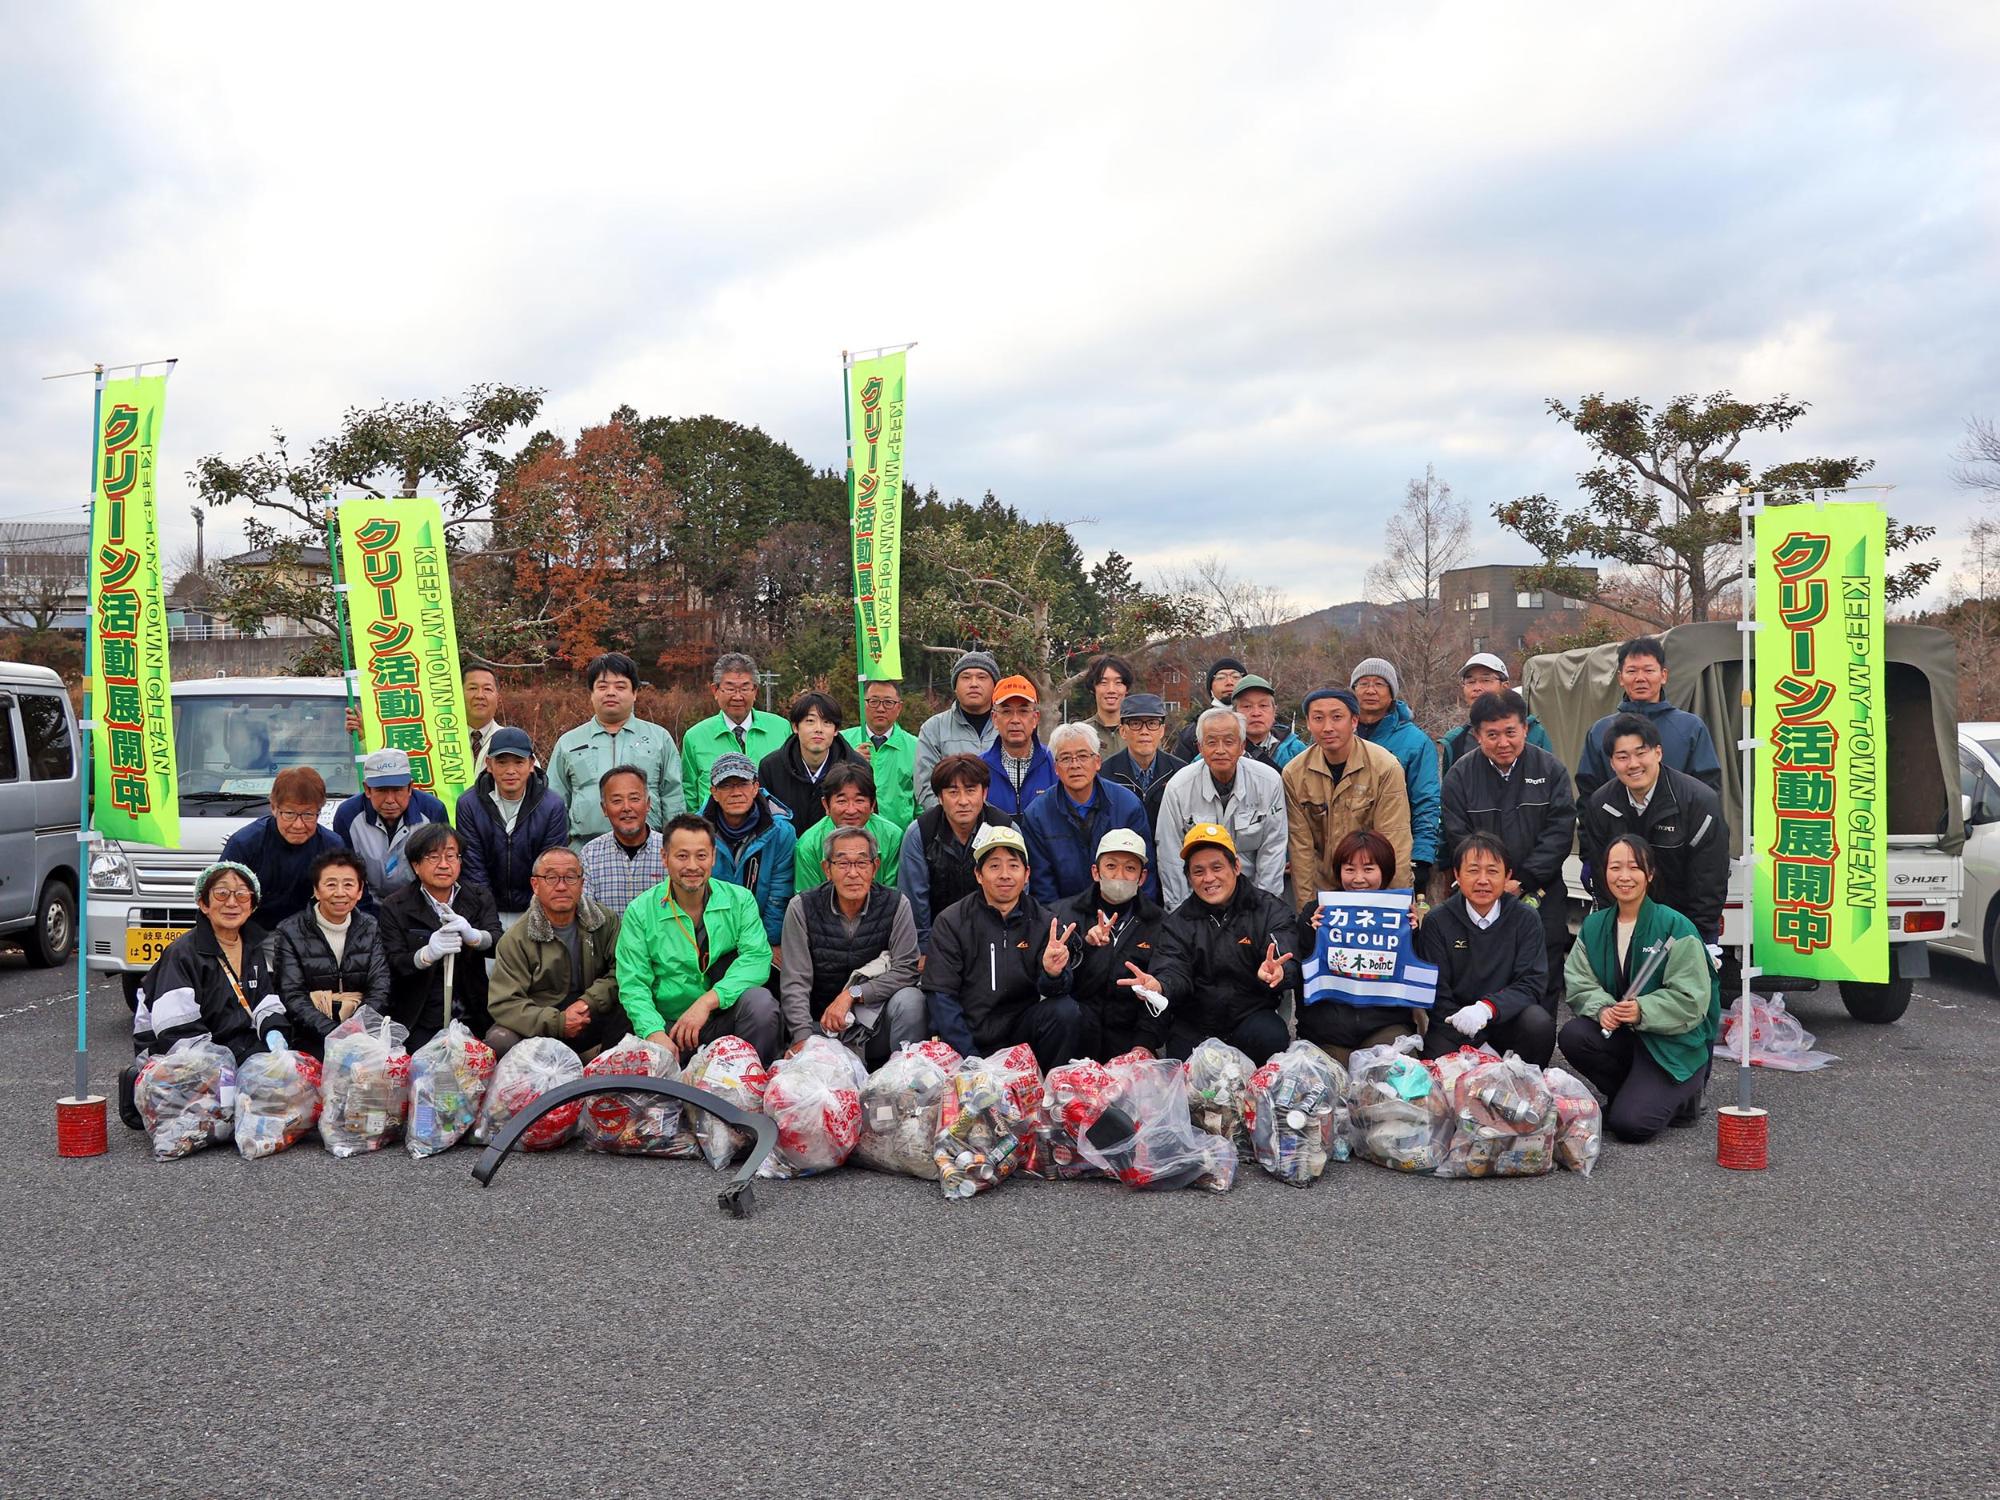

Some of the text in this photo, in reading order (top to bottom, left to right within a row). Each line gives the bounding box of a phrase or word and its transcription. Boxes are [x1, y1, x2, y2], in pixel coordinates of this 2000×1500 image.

[856, 377, 883, 664] クリーン活動展開中
[878, 400, 903, 629] KEEP MY TOWN CLEAN
[98, 404, 151, 819] クリーン活動展開中
[145, 583, 163, 668] TOWN
[354, 518, 437, 797] クリーン活動展開
[413, 547, 467, 785] KEEP MY TOWN CLEAN
[145, 677, 171, 775] CLEAN
[1768, 532, 1841, 955] クリーン活動展開中
[1841, 575, 1876, 909] KEEP MY TOWN CLEAN
[130, 948, 140, 956] は
[1328, 908, 1401, 930] カネコ
[1329, 928, 1399, 949] Group
[1911, 875, 1948, 883] HIJET
[1350, 953, 1367, 971] 木
[1369, 956, 1394, 971] Point
